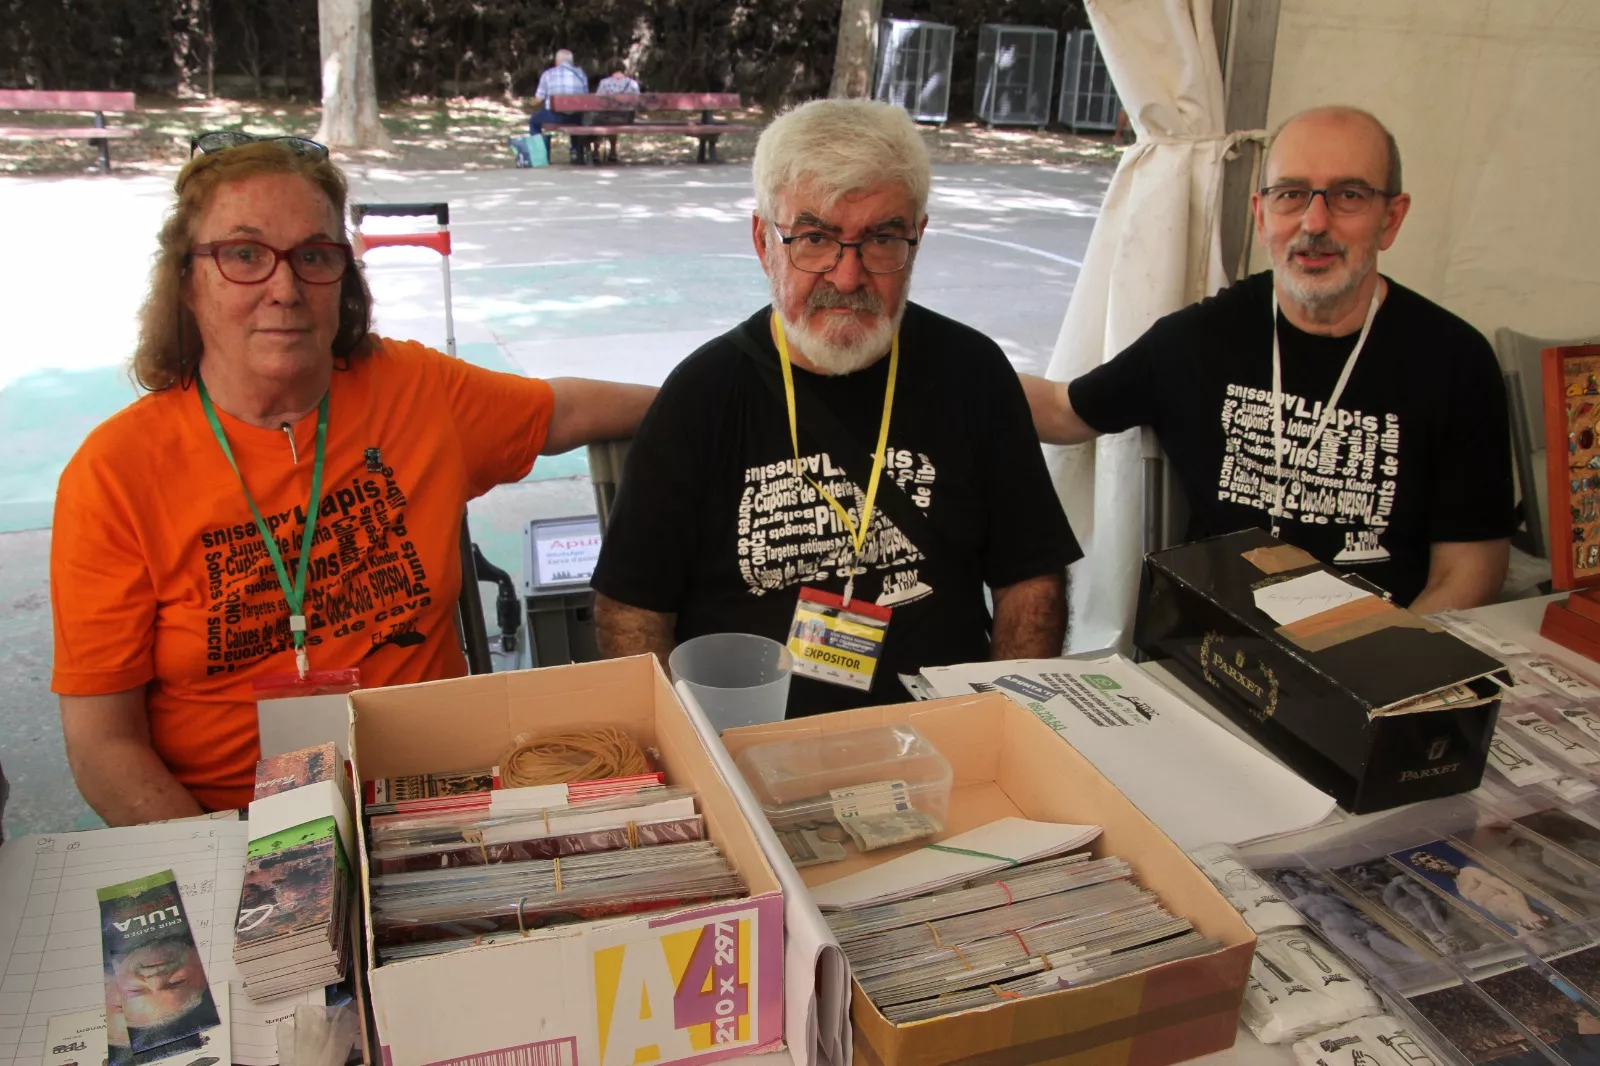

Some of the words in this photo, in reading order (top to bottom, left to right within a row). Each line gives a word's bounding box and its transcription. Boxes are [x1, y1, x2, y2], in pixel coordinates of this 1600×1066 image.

[1234, 408, 1269, 431] Cupons
[1286, 418, 1318, 438] loteri
[1380, 413, 1399, 454] llibre
[1342, 429, 1364, 476] Segells
[1361, 432, 1379, 480] Clauers
[1380, 455, 1399, 476] de
[1219, 455, 1235, 487] sucre
[1301, 470, 1344, 489] Sorpreses
[1345, 478, 1377, 493] Kinder
[294, 478, 381, 525] Lapis
[738, 486, 755, 535] Sobres
[754, 490, 798, 514] Cupons
[800, 484, 816, 503] de
[911, 487, 931, 508] de
[1300, 484, 1336, 515] Coca-Cola
[1337, 490, 1375, 525] Postals
[1371, 480, 1396, 526] Punts
[769, 522, 816, 540] Sotagots
[1301, 513, 1328, 524] de
[367, 550, 400, 568] Kinder
[752, 530, 767, 565] ONCE
[766, 543, 798, 562] Targetes
[401, 541, 430, 596] Punts
[367, 562, 413, 608] Postals
[242, 600, 277, 620] Targetes
[333, 620, 366, 638] de
[374, 596, 432, 622] cava
[207, 616, 222, 661] sucre
[225, 626, 260, 649] Caixes
[262, 621, 274, 641] de
[804, 647, 861, 670] EXPOSITOR
[1211, 652, 1264, 698] PARXET
[1398, 762, 1461, 783] PARXET
[112, 905, 180, 932] LULA
[123, 927, 156, 939] SADER
[159, 918, 182, 929] EMIR
[714, 922, 735, 966] 297
[602, 919, 749, 1066] A4
[720, 975, 735, 996] x
[265, 1012, 296, 1024] lendaris
[715, 999, 735, 1044] 210
